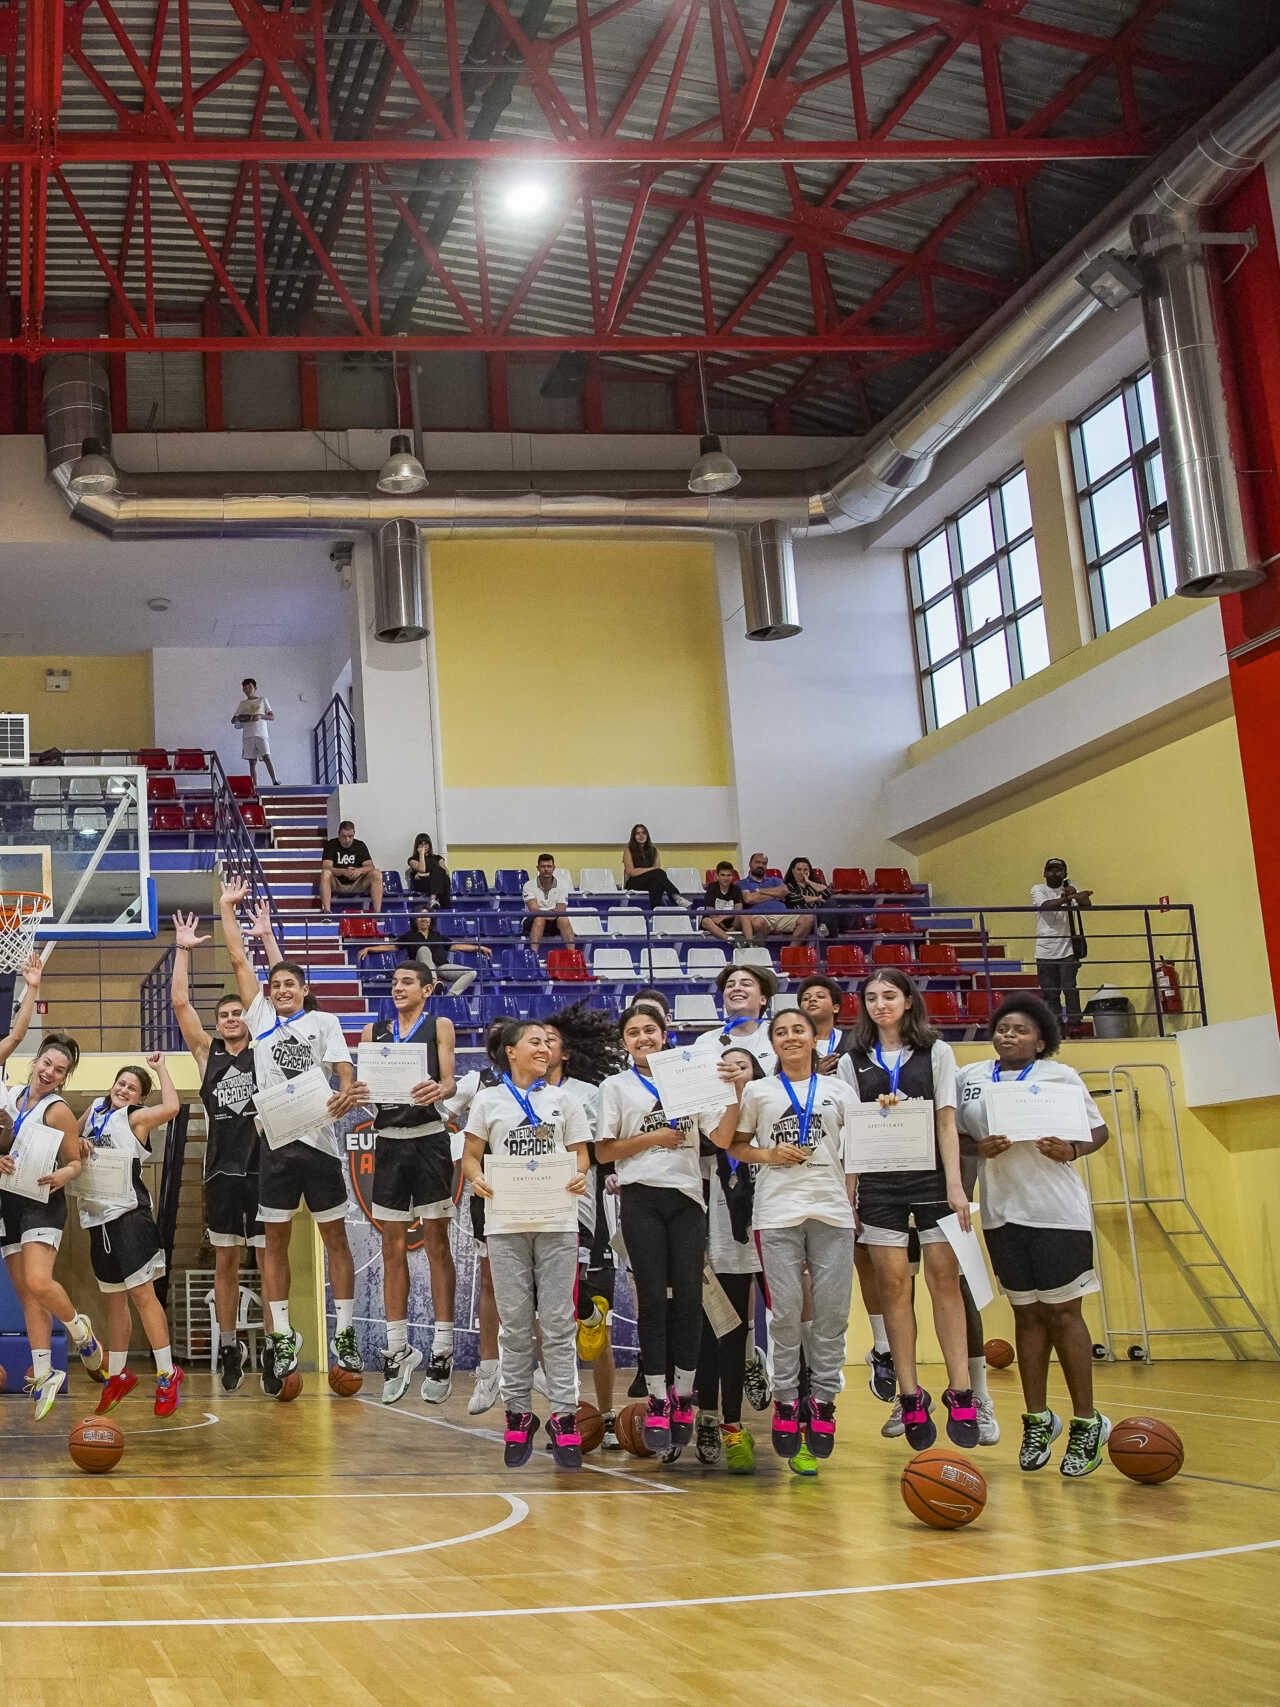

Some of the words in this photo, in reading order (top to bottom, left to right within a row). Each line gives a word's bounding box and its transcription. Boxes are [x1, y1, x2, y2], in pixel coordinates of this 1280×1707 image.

[337, 852, 356, 864] Lee
[964, 1087, 981, 1101] 32
[346, 1133, 376, 1150] EU
[509, 1139, 556, 1156] ACADEMY
